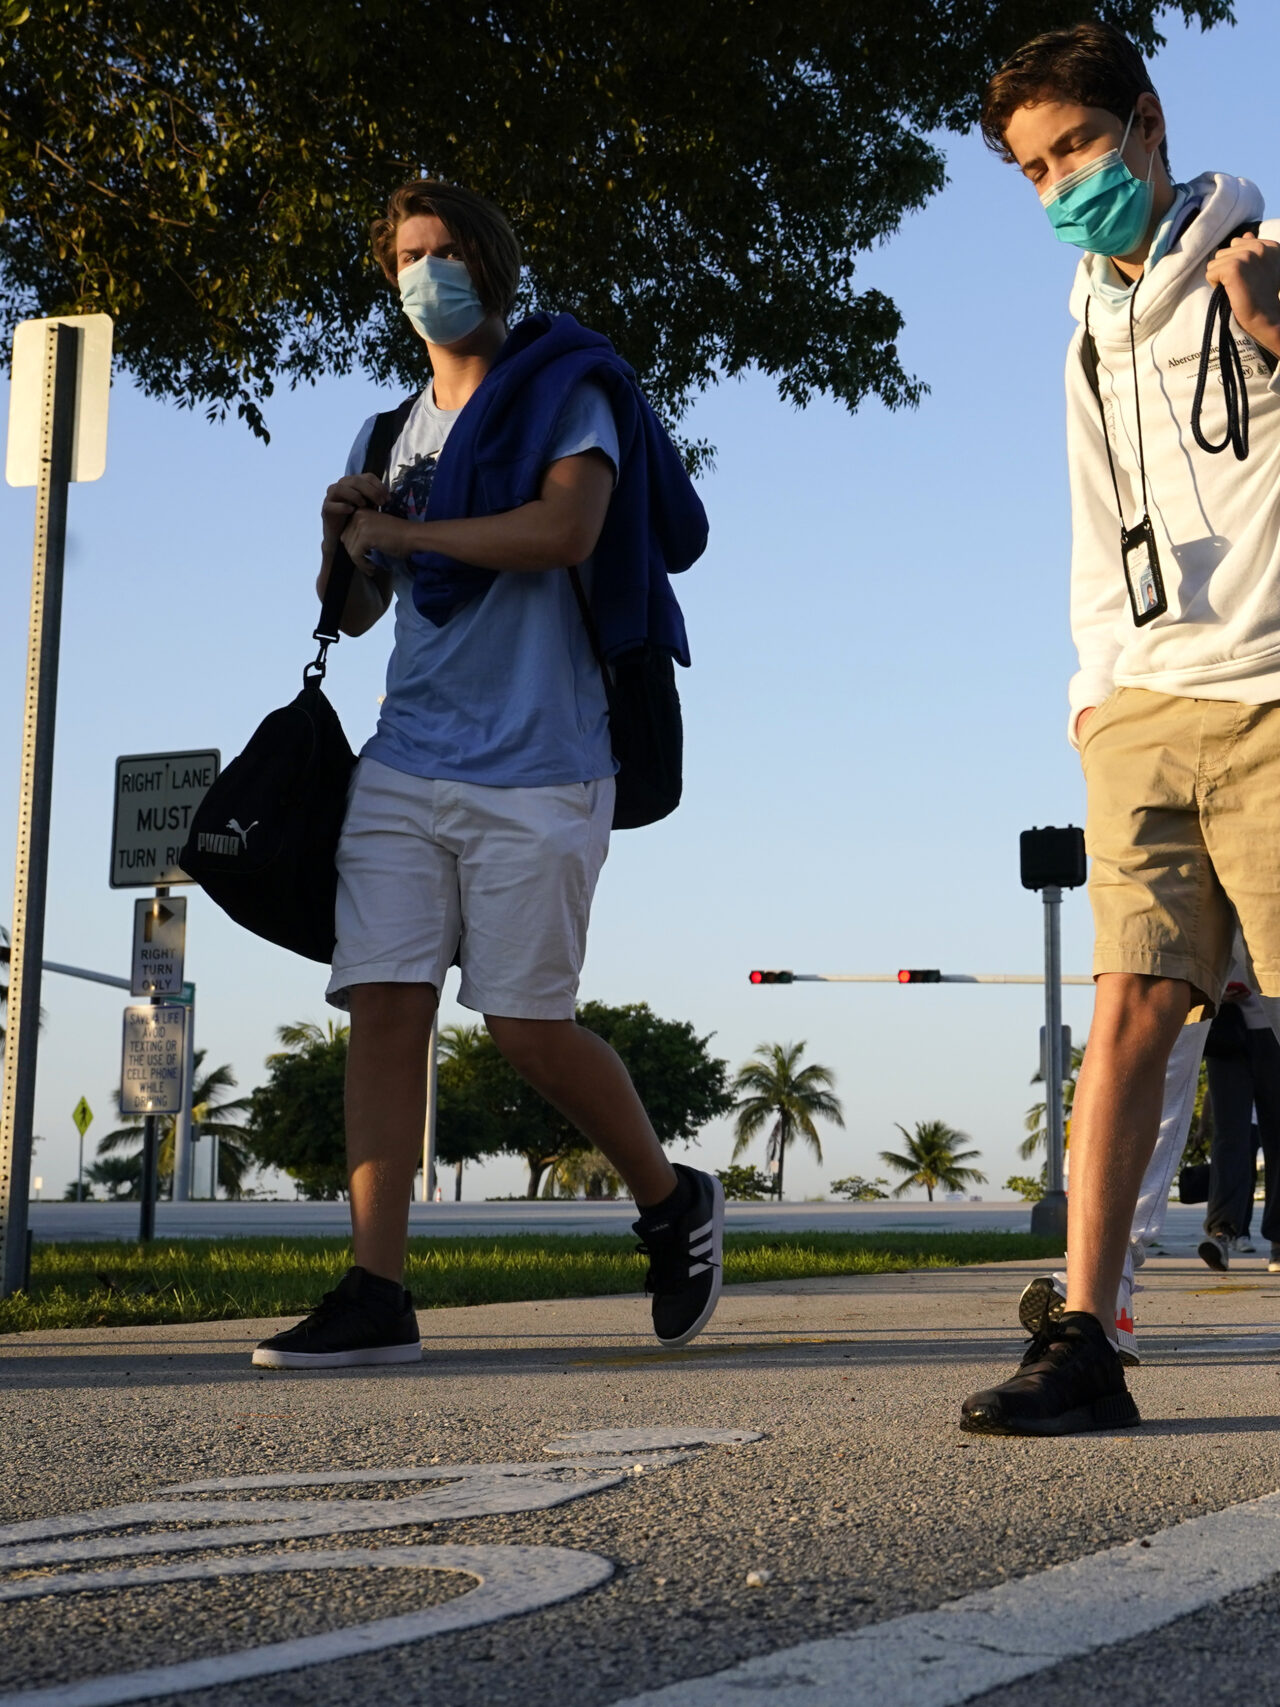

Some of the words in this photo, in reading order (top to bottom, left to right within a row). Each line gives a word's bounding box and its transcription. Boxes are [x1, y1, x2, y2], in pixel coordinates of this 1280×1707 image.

[122, 772, 163, 792] RIGHT
[172, 768, 211, 789] LANE
[137, 805, 192, 832] MUST
[197, 832, 240, 856] PUMA
[119, 848, 156, 869] TURN
[140, 948, 176, 961] RIGHT
[142, 964, 173, 975] TURN
[142, 979, 172, 991] ONLY
[162, 1012, 179, 1024] LIFE
[142, 1026, 166, 1038] AVOID
[130, 1041, 163, 1052] TEXTING
[165, 1040, 177, 1052] OR
[129, 1054, 144, 1066] THE
[146, 1054, 163, 1066] USE
[165, 1054, 178, 1066] OF
[127, 1068, 147, 1080] CELL
[150, 1068, 178, 1080] PHONE
[139, 1081, 165, 1093] WHILE
